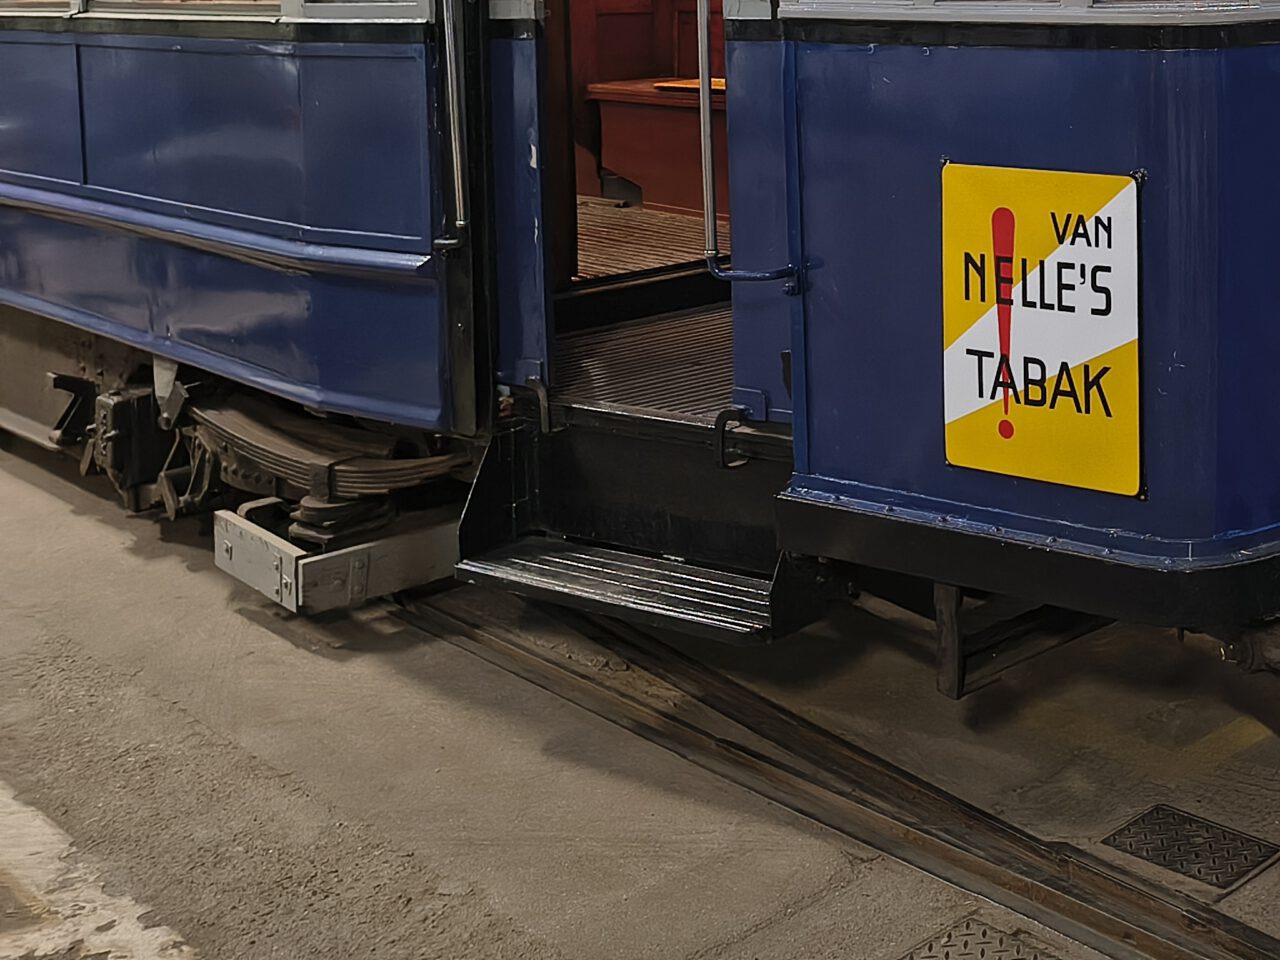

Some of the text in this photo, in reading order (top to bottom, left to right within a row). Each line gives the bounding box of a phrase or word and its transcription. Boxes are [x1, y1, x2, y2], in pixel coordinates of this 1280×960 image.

[1051, 211, 1113, 250] VAN
[963, 250, 1113, 318] NELLE'S
[965, 348, 1113, 418] TABAK
